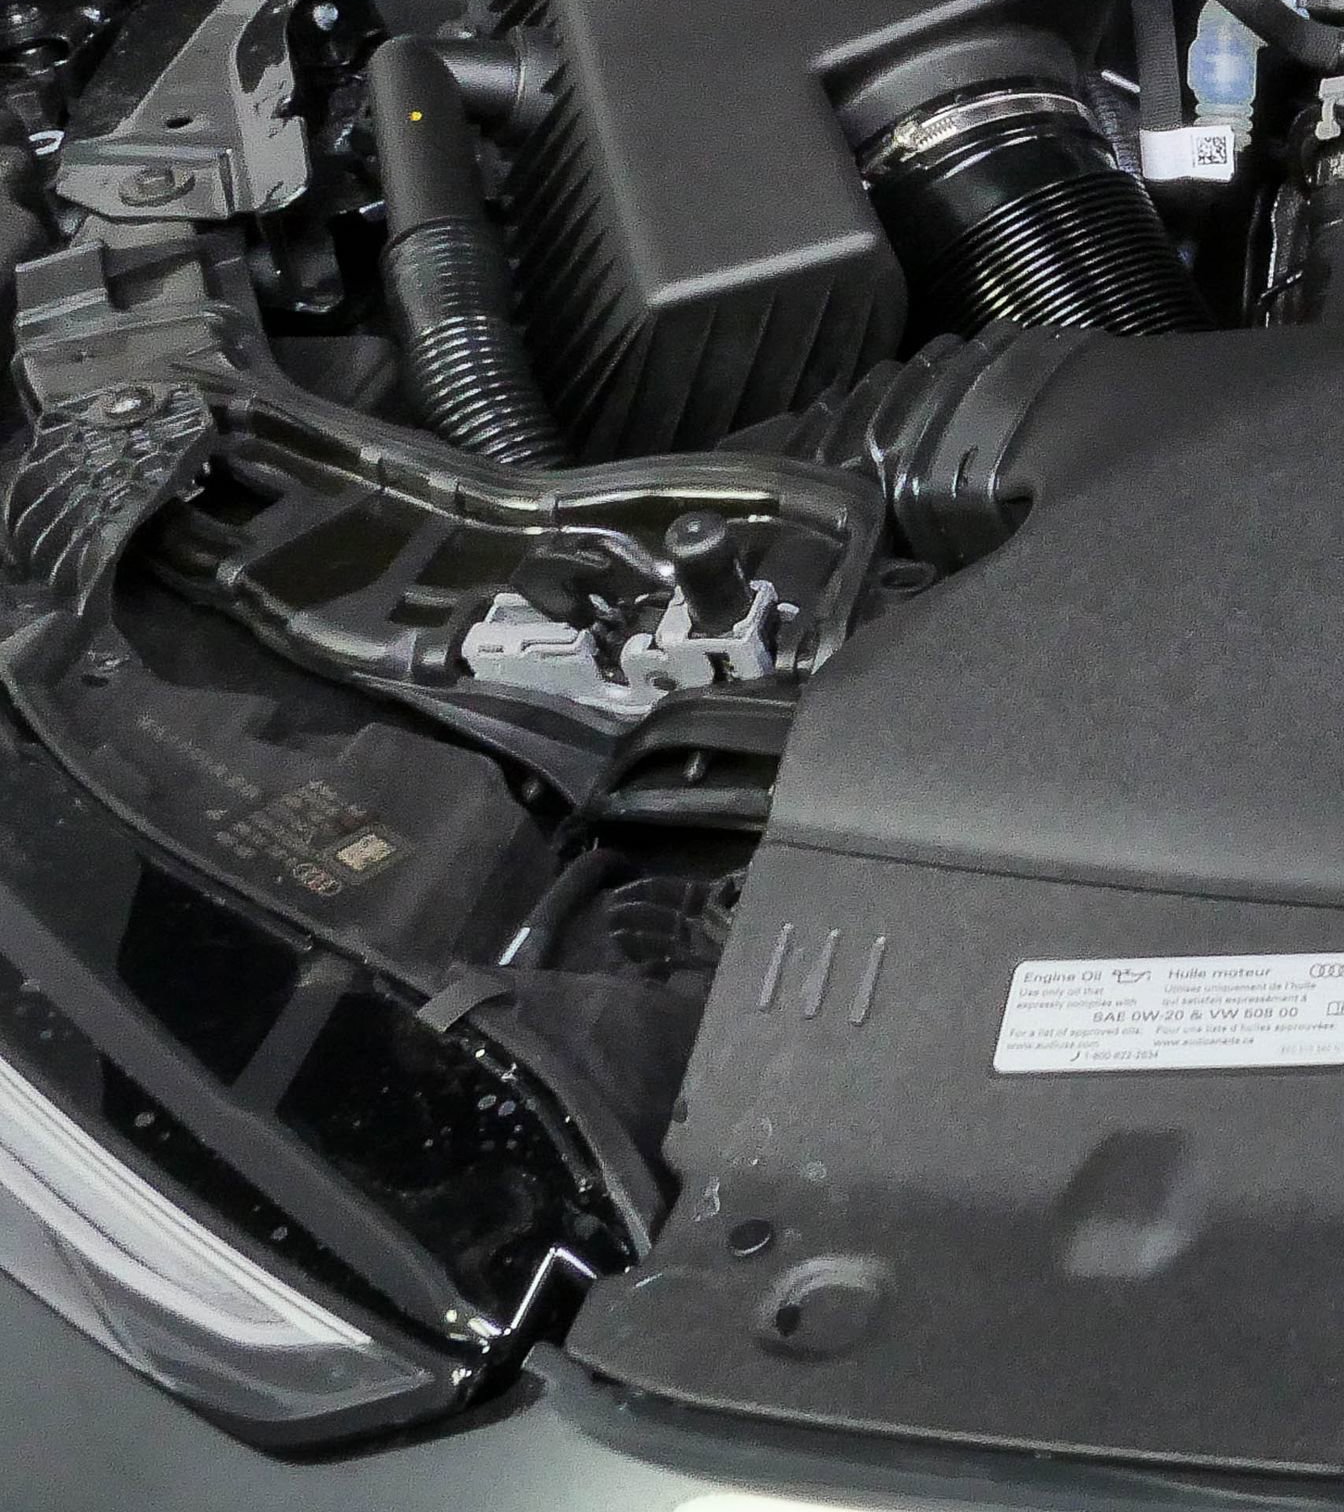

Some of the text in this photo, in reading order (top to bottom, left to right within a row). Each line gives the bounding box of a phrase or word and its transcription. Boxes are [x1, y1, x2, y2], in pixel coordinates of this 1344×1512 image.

[1024, 971, 1102, 985] Engine Oil
[1168, 968, 1271, 979] Huile moteur
[1092, 1012, 1125, 1022] SAE
[1132, 1010, 1184, 1022] 0W-20
[1190, 1010, 1202, 1020] &
[1210, 1008, 1239, 1019] VW
[1278, 1007, 1298, 1017] 00
